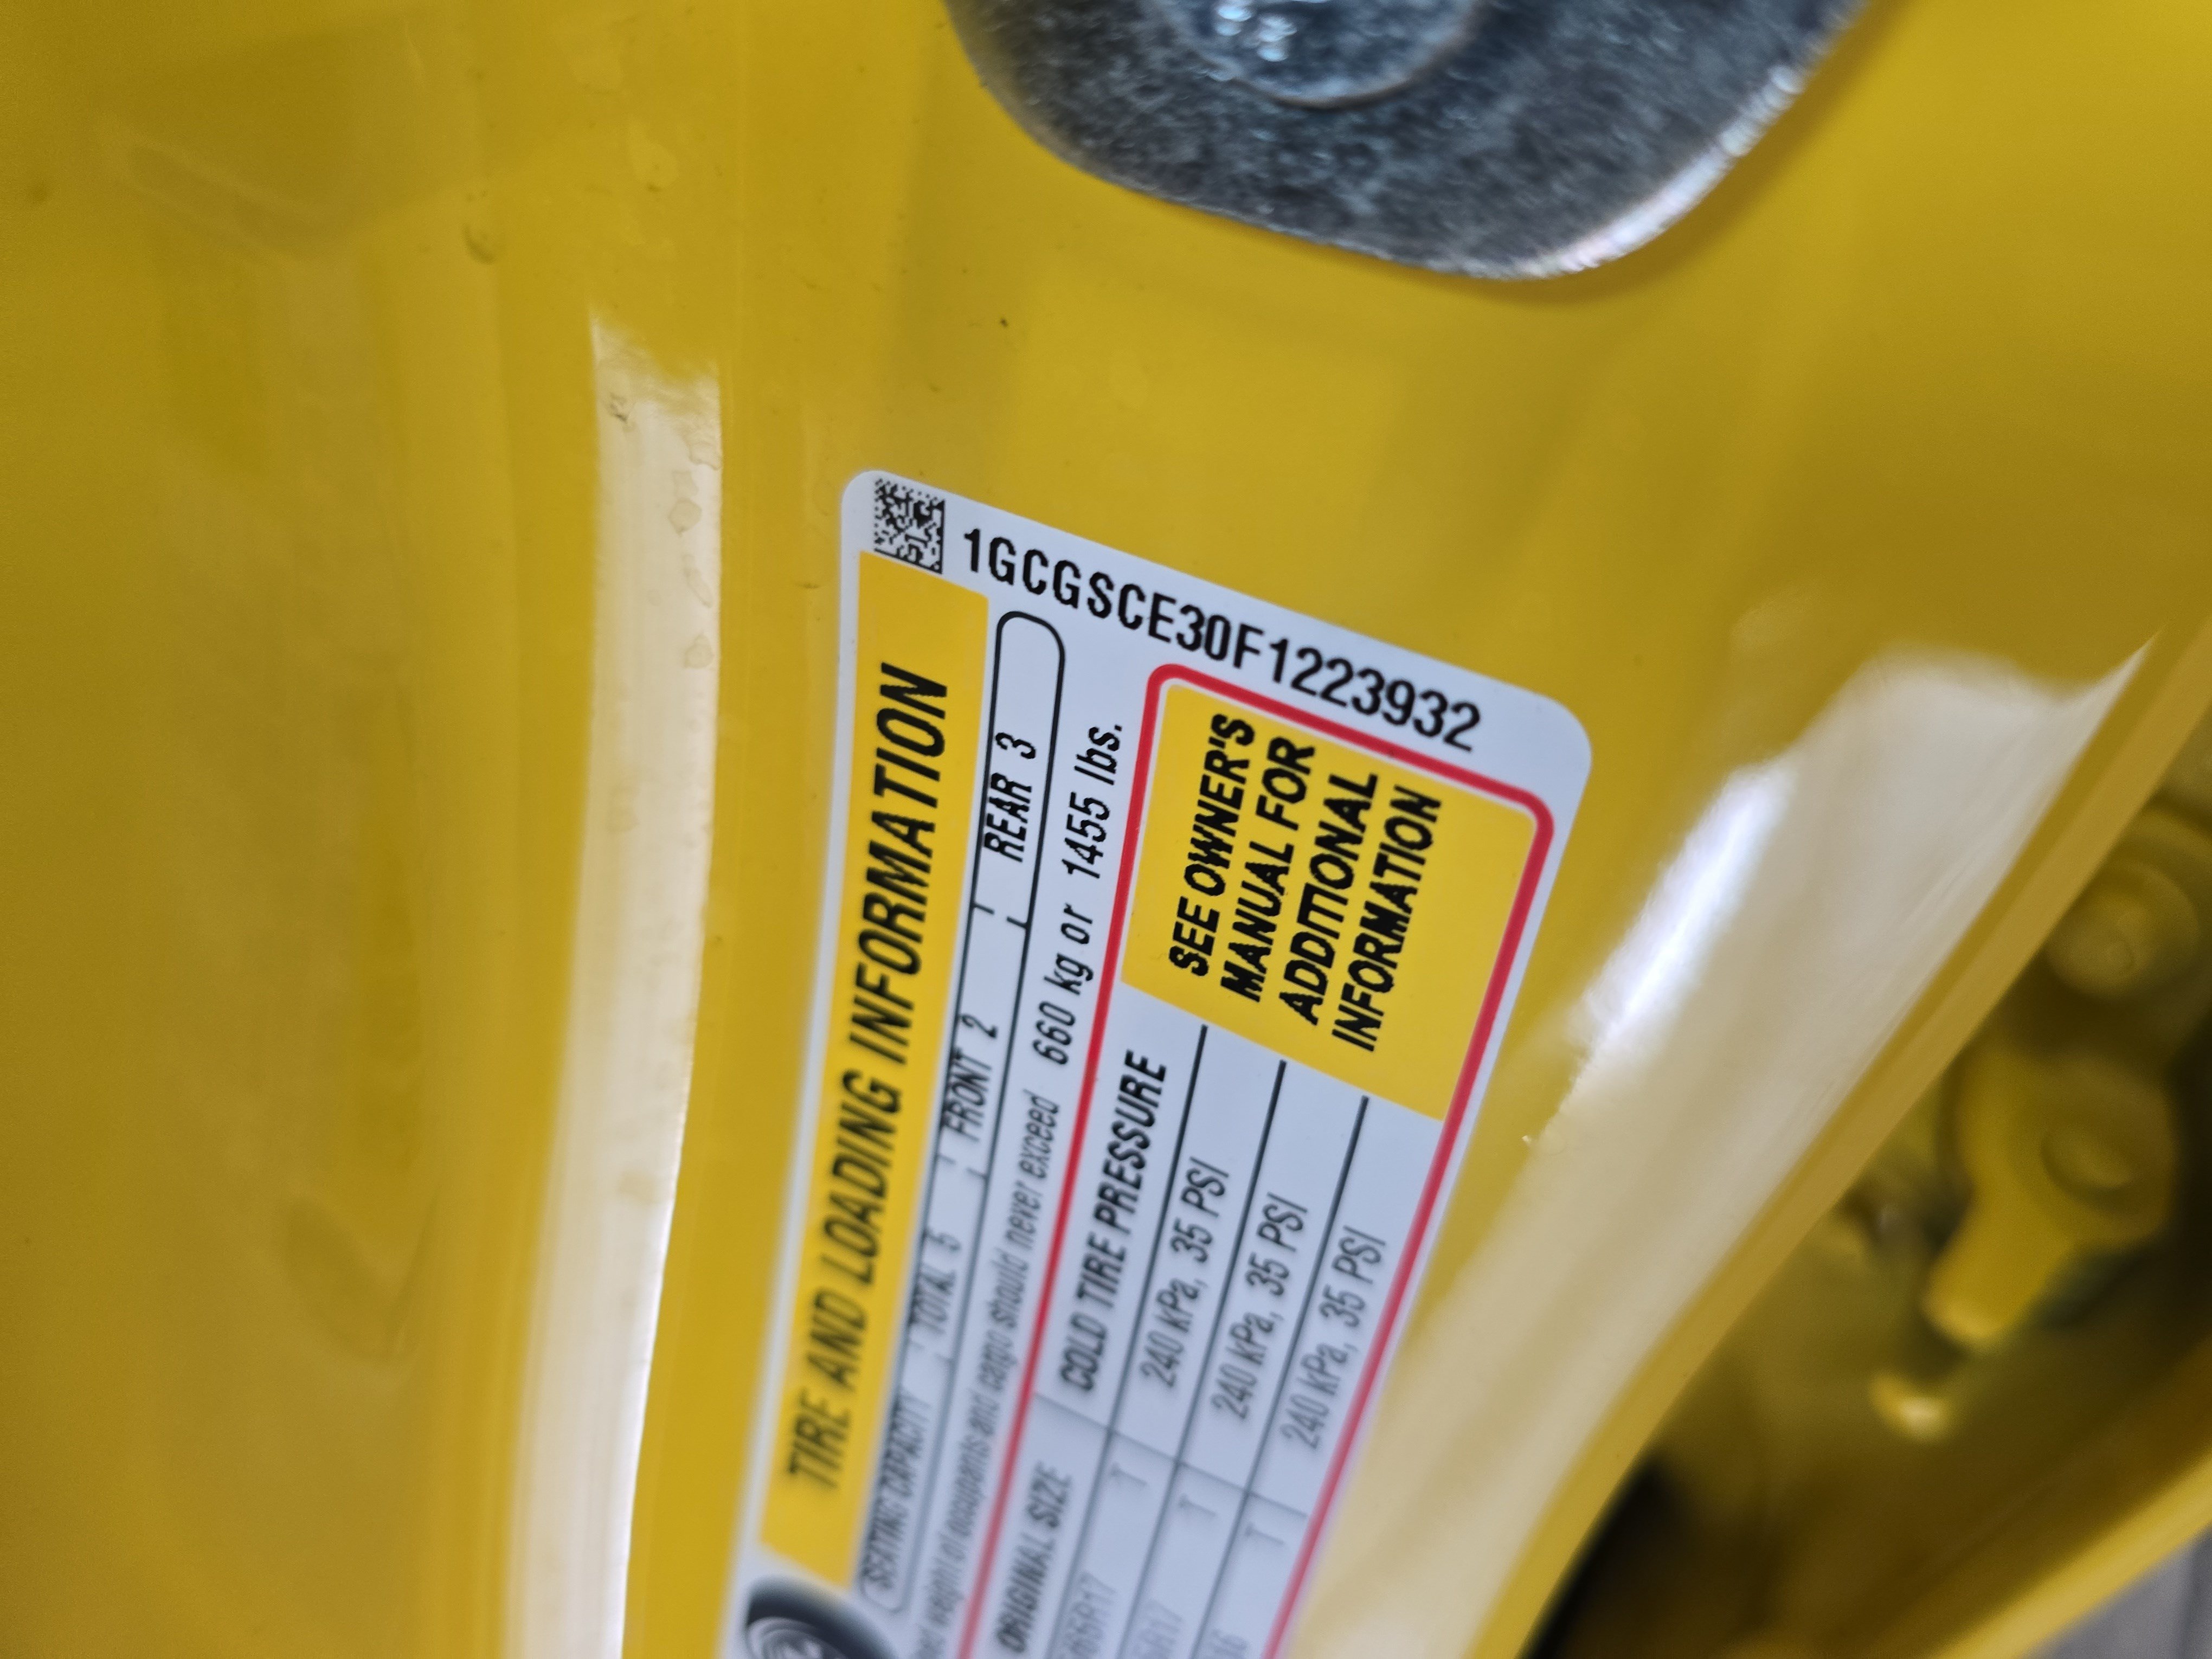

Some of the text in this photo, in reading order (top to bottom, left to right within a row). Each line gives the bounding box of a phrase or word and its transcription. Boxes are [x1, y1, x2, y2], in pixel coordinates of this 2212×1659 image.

[964, 529, 1481, 752] 1GCGSCE30F1223932
[984, 732, 1037, 862] REAR 3
[1074, 723, 1122, 785] lbs.
[1062, 792, 1110, 878] 1455
[1169, 713, 1254, 977] SEE OWNER'S
[1220, 736, 1316, 1002] MANUAL FOR
[1278, 773, 1378, 1025] ADDITIONAL
[1044, 953, 1094, 994] kg
[1061, 903, 1093, 944] or
[1331, 785, 1441, 1052] INFORMATION
[788, 661, 947, 1488] TIRE AND LOADING INFORMATION
[944, 1014, 997, 1141] FRONT 2
[1033, 1001, 1076, 1065] 660
[1023, 1089, 1060, 1179] exceed
[989, 1249, 1028, 1329] should
[1005, 1180, 1043, 1250] never
[1060, 1050, 1167, 1392] COLD TIRE PRESSURE
[1140, 1156, 1229, 1388] 240 kPa, 35 PSI
[910, 1271, 957, 1335] TOTAL
[1210, 1192, 1308, 1421] 240 kPa, 35 PSI
[1281, 1225, 1386, 1450] 240 kPa, 35 PSI
[996, 1461, 1072, 1653] ORIGINAL SIZE
